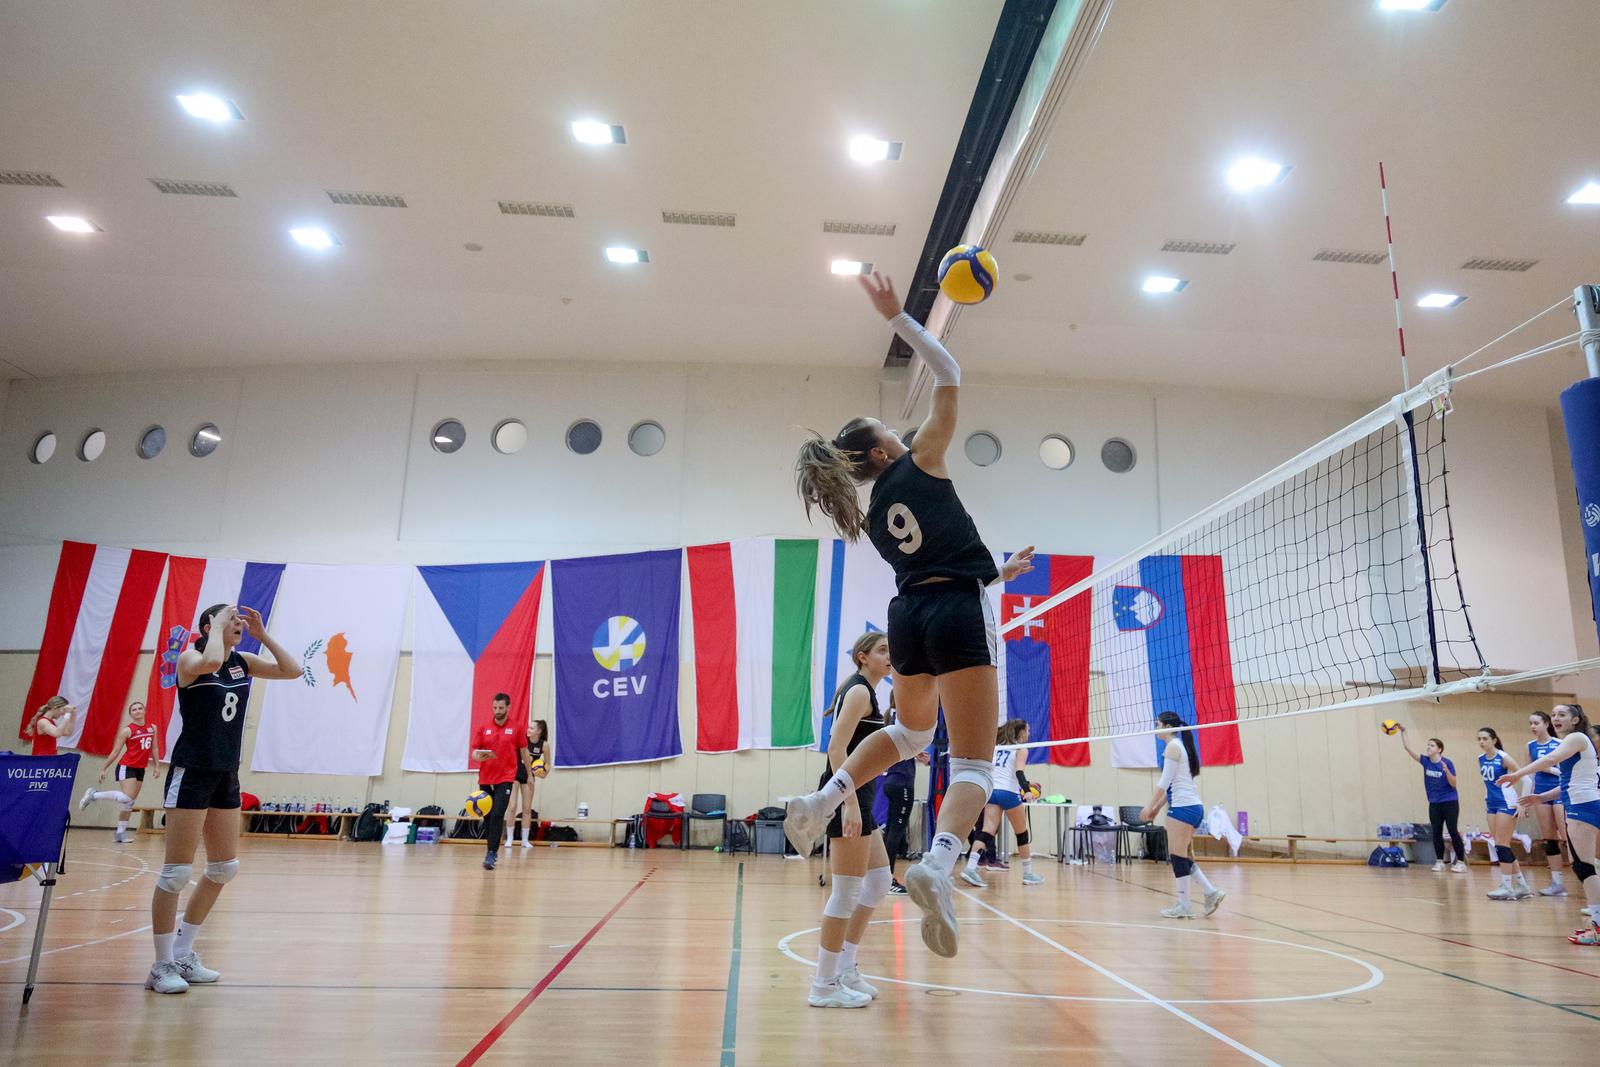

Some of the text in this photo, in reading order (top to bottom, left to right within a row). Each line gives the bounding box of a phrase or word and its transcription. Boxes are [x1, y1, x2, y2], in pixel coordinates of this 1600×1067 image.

[887, 502, 923, 555] 9
[592, 675, 647, 698] CEV
[221, 691, 239, 722] 8
[140, 737, 152, 750] 16
[995, 750, 1011, 768] 27
[7, 768, 72, 778] VOLLEYBALL
[1480, 765, 1495, 781] 20
